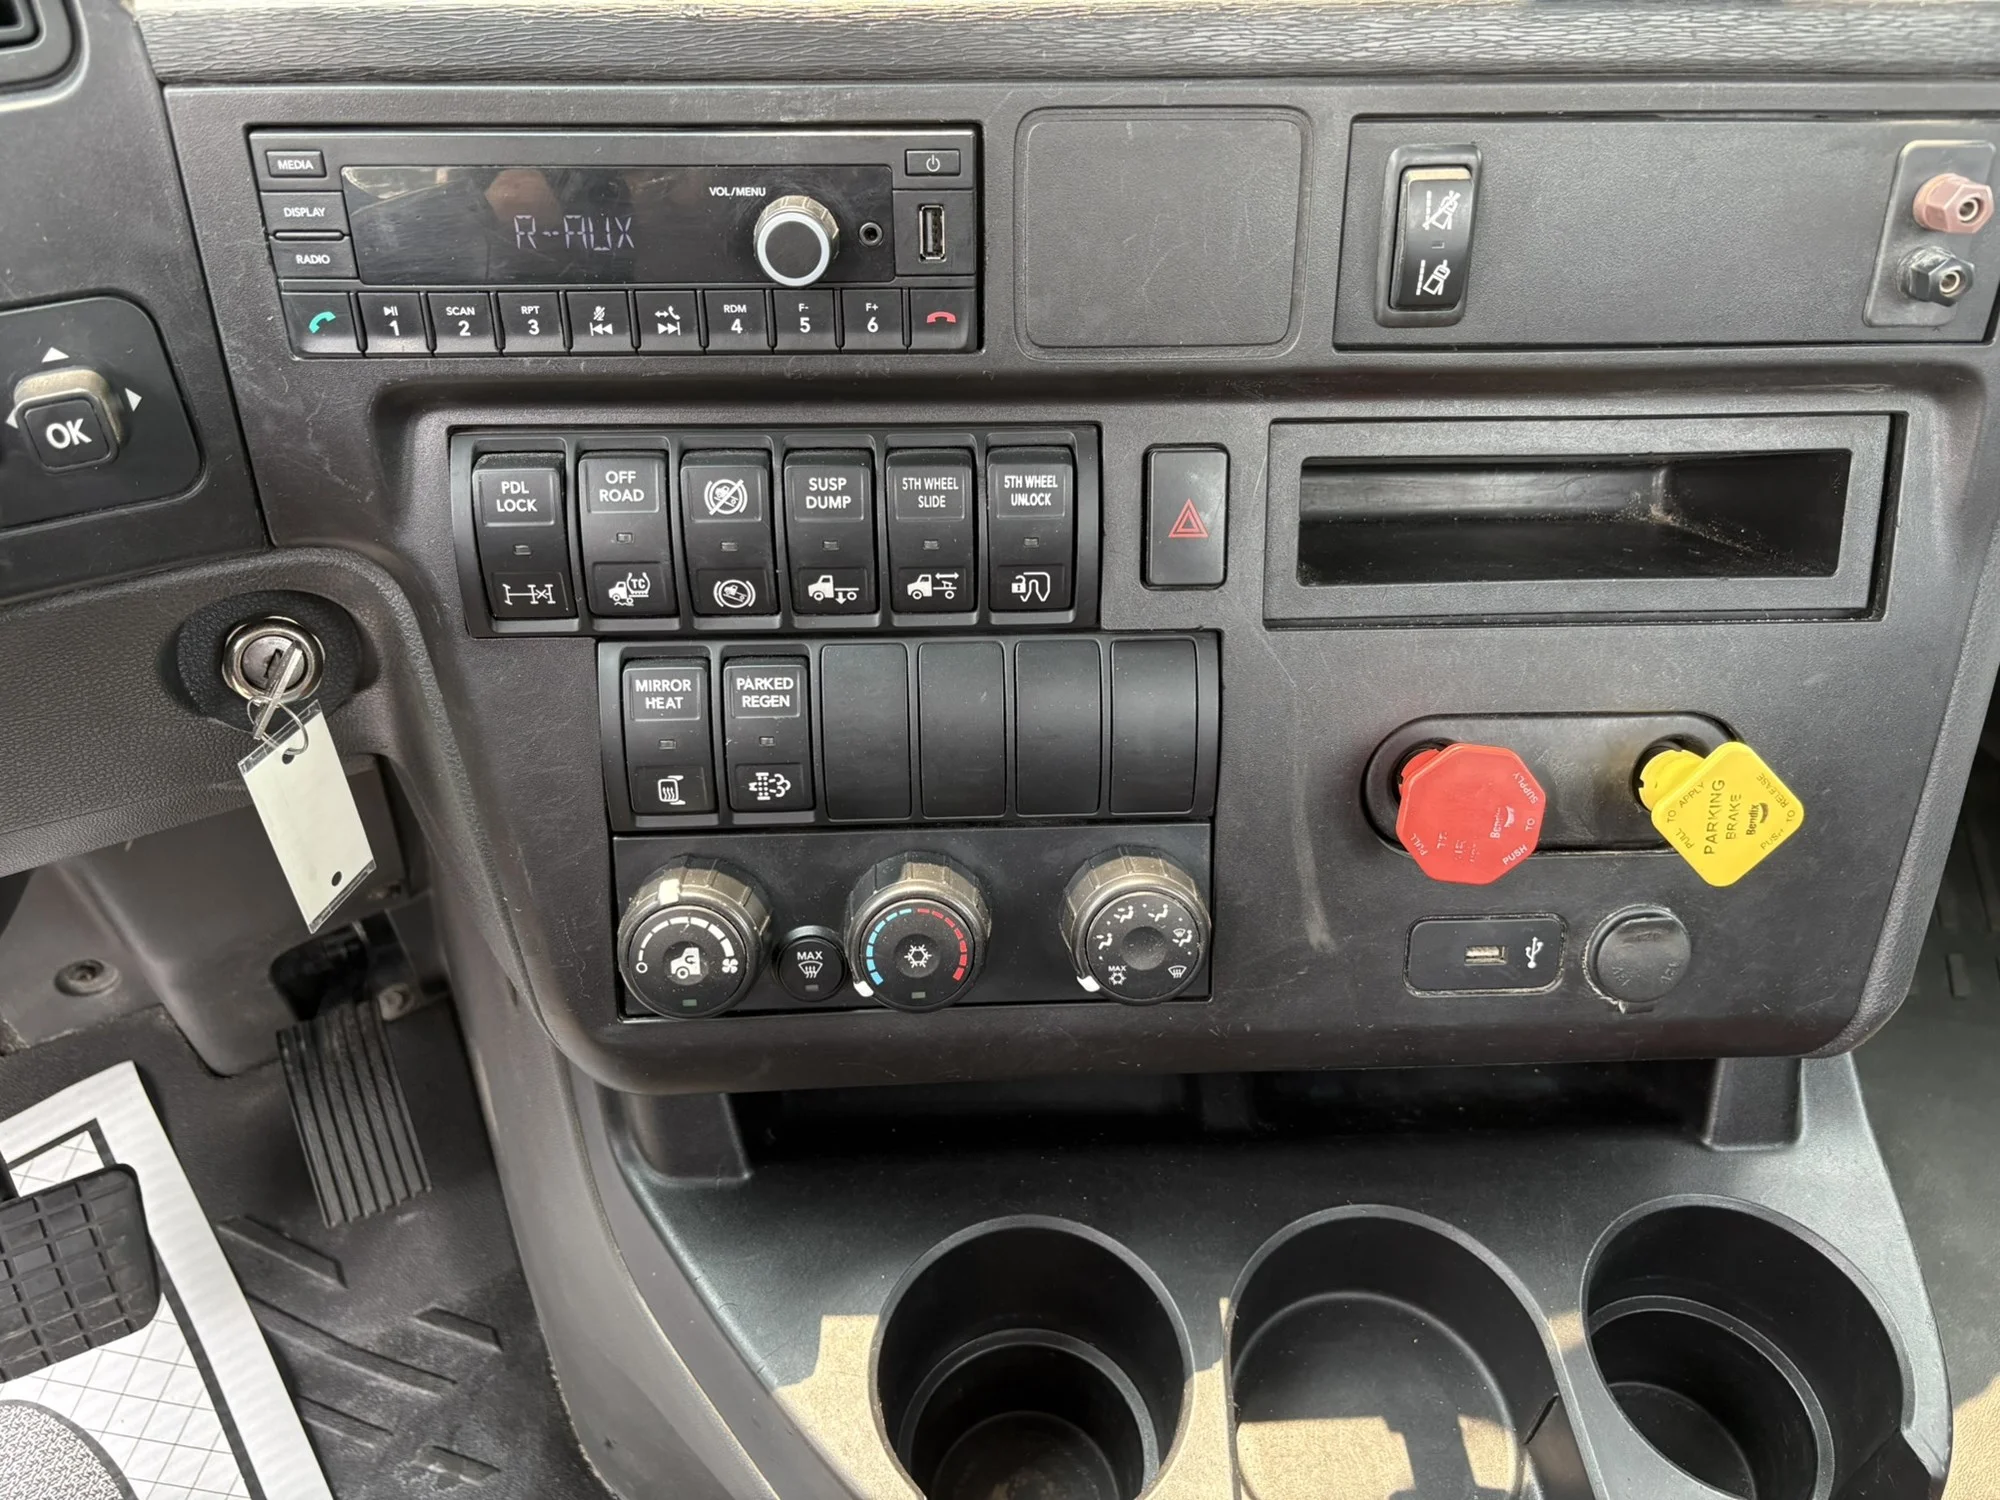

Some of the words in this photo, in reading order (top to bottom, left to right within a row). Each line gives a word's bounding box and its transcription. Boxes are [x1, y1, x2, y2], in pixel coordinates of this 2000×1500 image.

[277, 159, 314, 171] MEDIA
[708, 187, 766, 197] VOL/MENU
[283, 206, 325, 218] DISPLAY
[513, 214, 635, 251] R-AUX
[296, 254, 330, 265] RADIO
[446, 306, 475, 316] SCAN
[521, 305, 540, 315] RPT
[723, 304, 747, 313] RDM
[389, 320, 400, 336] 1
[457, 320, 471, 336] 2
[528, 320, 540, 335] 3
[730, 319, 743, 333] 4
[800, 318, 810, 333] 5
[867, 318, 878, 333] 6
[46, 418, 93, 449] OK
[605, 470, 636, 485] OFF
[808, 477, 847, 491] SUSP
[902, 477, 921, 490] 5TH
[923, 477, 959, 490] WHEEL
[1004, 475, 1023, 489] 5TH
[1024, 475, 1058, 489] WHEEL
[501, 481, 529, 494] PDL
[599, 489, 645, 503] ROAD
[805, 496, 852, 509] DUMP
[918, 495, 946, 508] SLIDE
[1010, 493, 1052, 507] UNLOCK
[496, 499, 538, 512] LOCK
[630, 578, 646, 589] TC
[635, 679, 692, 692] MIRROR
[736, 677, 794, 690] PARKED
[645, 697, 684, 709] HEAT
[742, 695, 790, 708] REGEN
[1512, 772, 1539, 804] SUPPLY
[1679, 781, 1705, 808] APPLY
[1756, 773, 1789, 808] RELEASE
[1667, 809, 1677, 824] TO
[1704, 779, 1725, 855] PARKING
[1726, 793, 1742, 840] BRAKE
[1746, 804, 1760, 836] Bendix
[1786, 810, 1796, 823] TO
[1525, 817, 1537, 831] TO
[1675, 827, 1695, 849] PULL
[1502, 844, 1528, 865] PUSH
[797, 951, 823, 961] MAX
